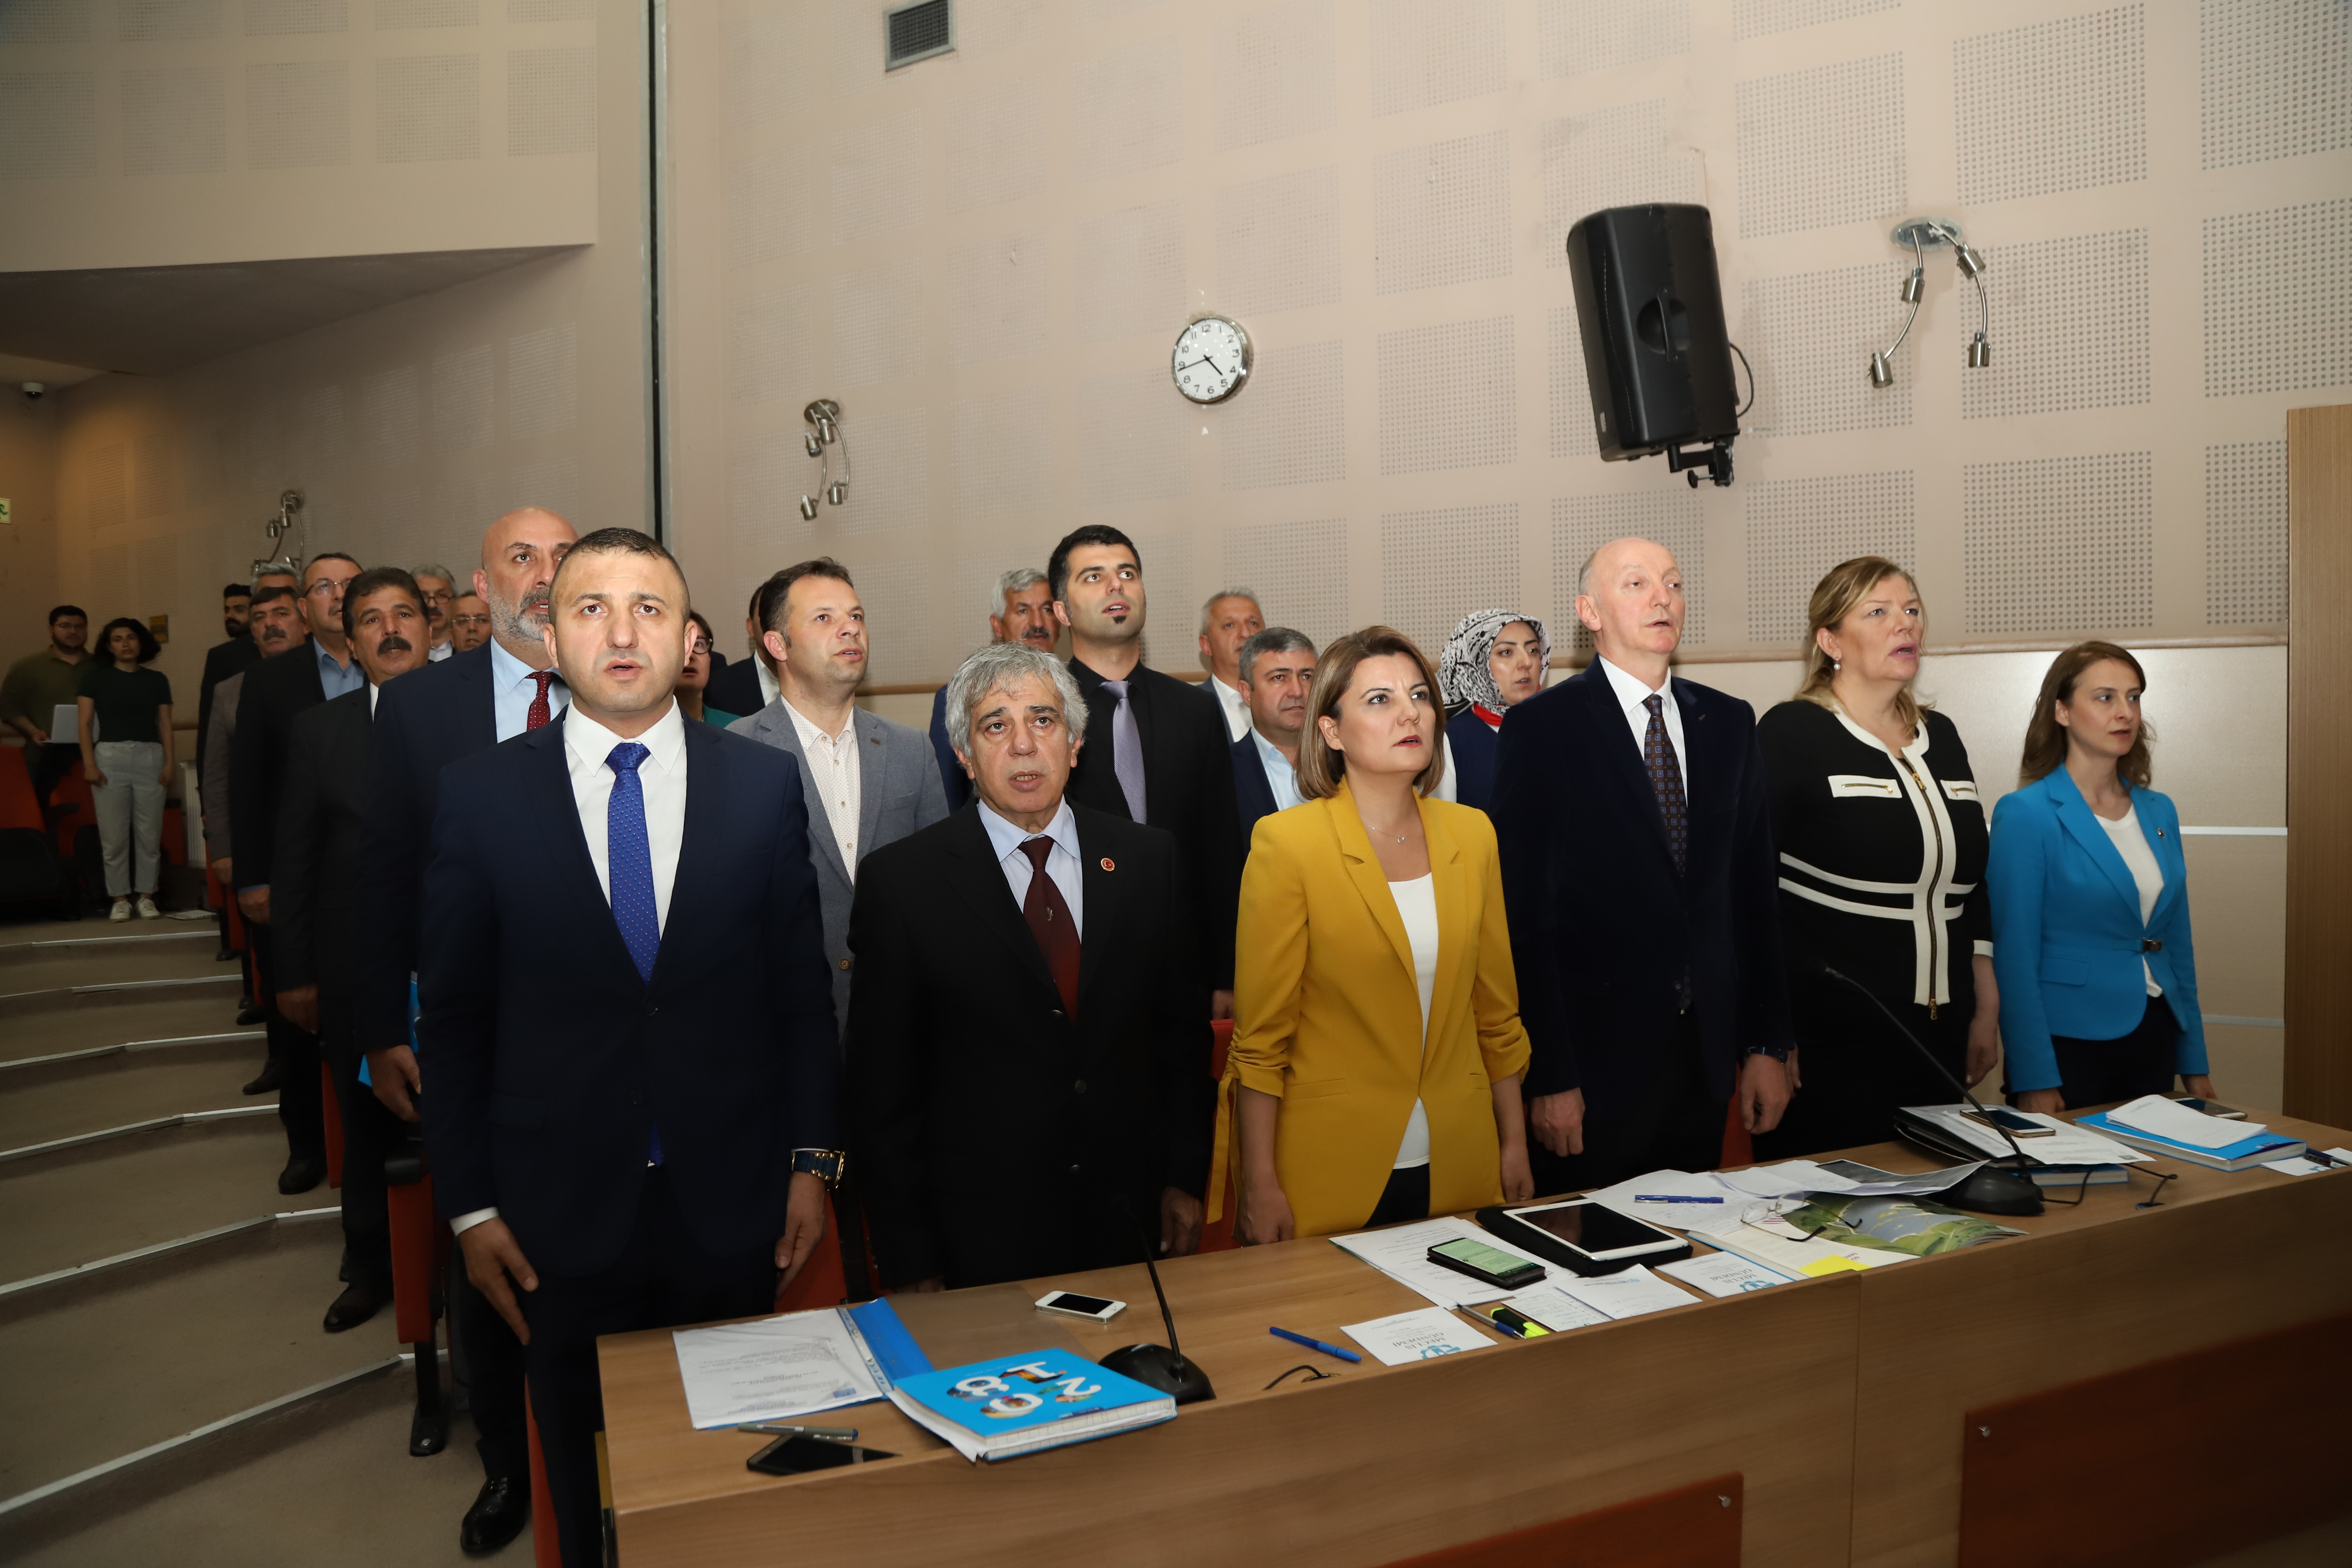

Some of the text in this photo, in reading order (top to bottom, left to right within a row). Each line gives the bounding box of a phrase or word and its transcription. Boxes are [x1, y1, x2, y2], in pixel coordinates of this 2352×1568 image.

[1228, 335, 1234, 343] 2
[1233, 349, 1239, 357] 3
[1179, 361, 1185, 370] 9
